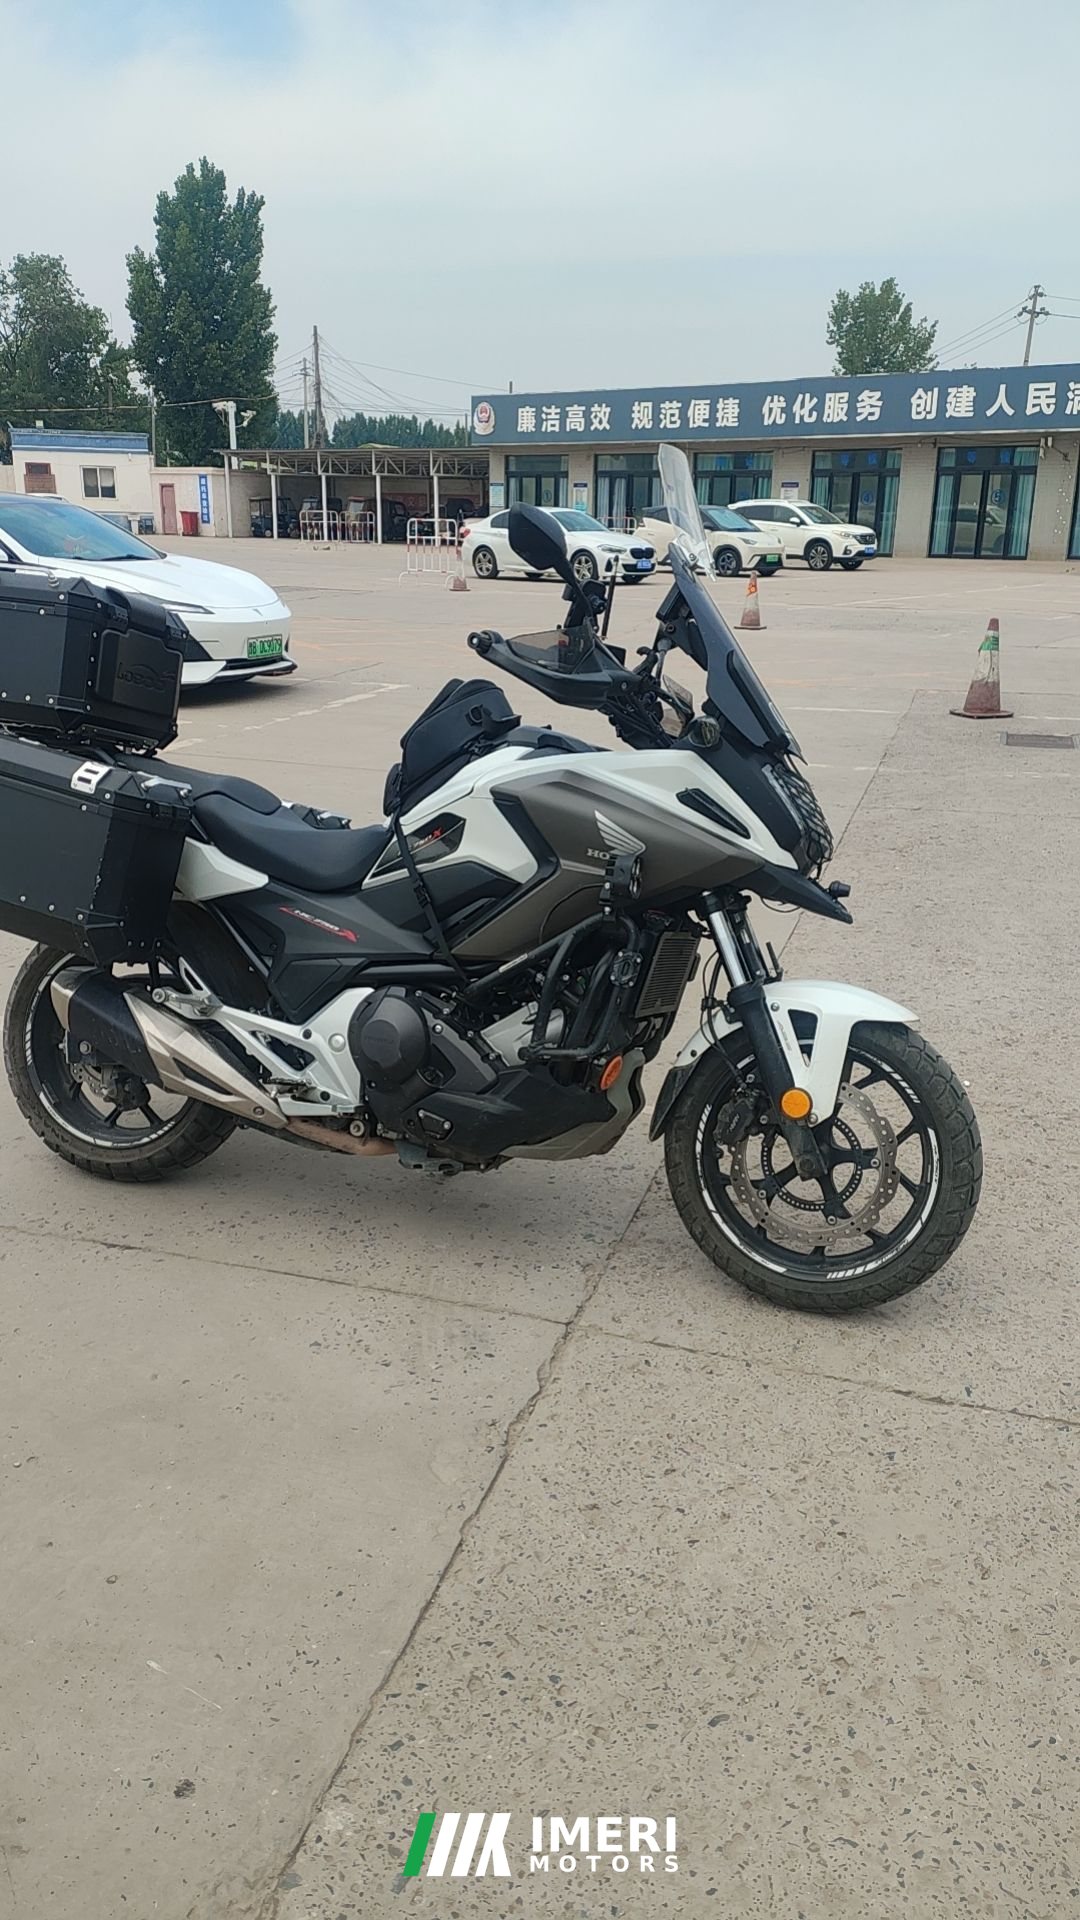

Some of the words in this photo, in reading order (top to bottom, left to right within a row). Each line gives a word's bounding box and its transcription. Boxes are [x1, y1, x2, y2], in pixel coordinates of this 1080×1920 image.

[516, 401, 612, 433] 廉洁高效
[631, 397, 740, 430] 规范便捷
[761, 389, 884, 426] 优化服务
